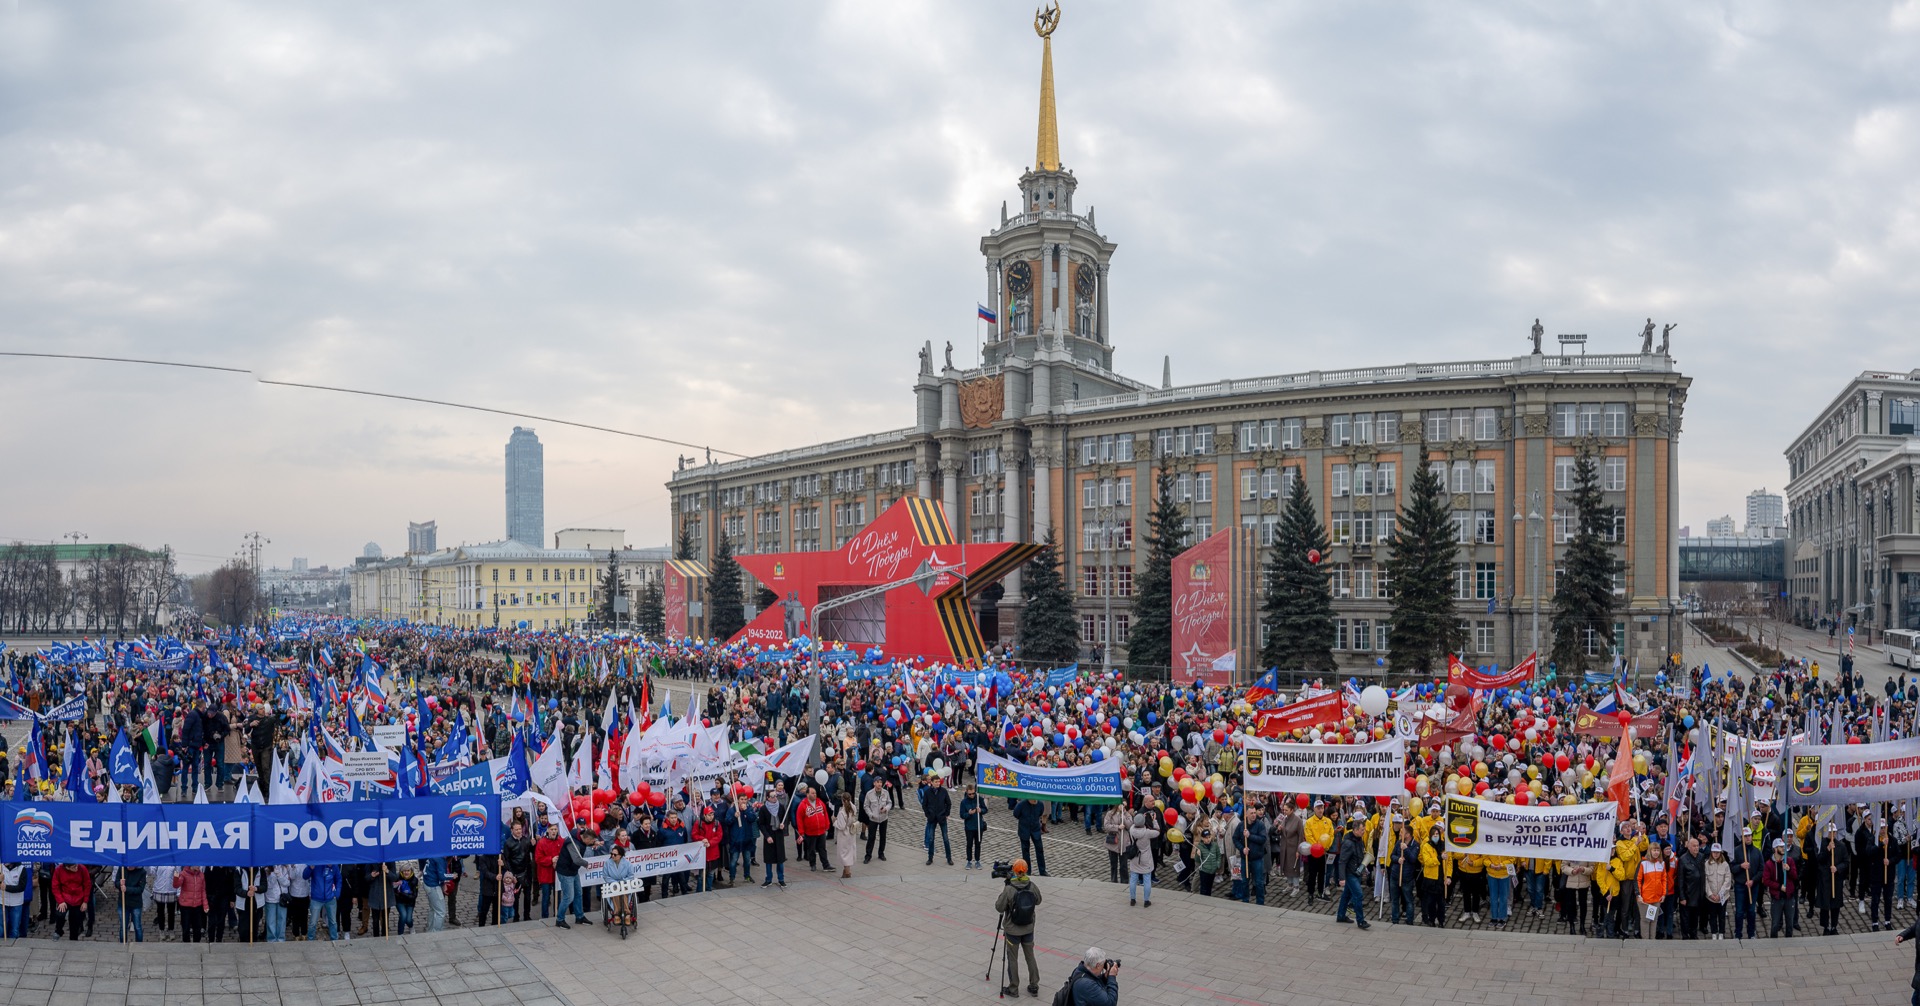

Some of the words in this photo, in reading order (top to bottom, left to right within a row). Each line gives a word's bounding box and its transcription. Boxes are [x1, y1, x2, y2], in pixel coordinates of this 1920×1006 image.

[848, 537, 860, 565] С
[862, 531, 899, 558] Днём
[866, 535, 915, 579] Победы!
[1174, 593, 1187, 616] С
[1179, 602, 1227, 637] Победы!
[747, 628, 783, 640] 1945-2022
[1266, 751, 1316, 763] ГОРНЯКАМ
[1318, 752, 1325, 763] И
[1326, 752, 1393, 764] МЕТАЛЛУРГАМ
[1266, 764, 1318, 778] РЕАЛЬНЫЙ
[1318, 767, 1342, 778] РОСТ
[1343, 767, 1401, 779] ЗАРПЛАТЫ!
[439, 775, 487, 794] ЗАБОТУ,
[1020, 778, 1082, 791] Свердловской
[1829, 774, 1887, 789] ПРОФСОЮЗ
[1889, 770, 1920, 785] РОССИ
[1450, 802, 1476, 814] ГМПР
[1480, 809, 1541, 823] ПОДДЕРЖКА
[70, 820, 250, 854] ЕДИНАЯ
[274, 814, 434, 850] РОССИЯ
[1515, 824, 1542, 834] ЭТО
[1545, 822, 1588, 836] ВКЛАД
[451, 842, 485, 850] РОССИЯ
[1485, 834, 1494, 843] В
[1497, 835, 1557, 848] БУДУЩЕЕ
[645, 860, 678, 872] ФРОНТ
[600, 878, 645, 896] #ОНФ
